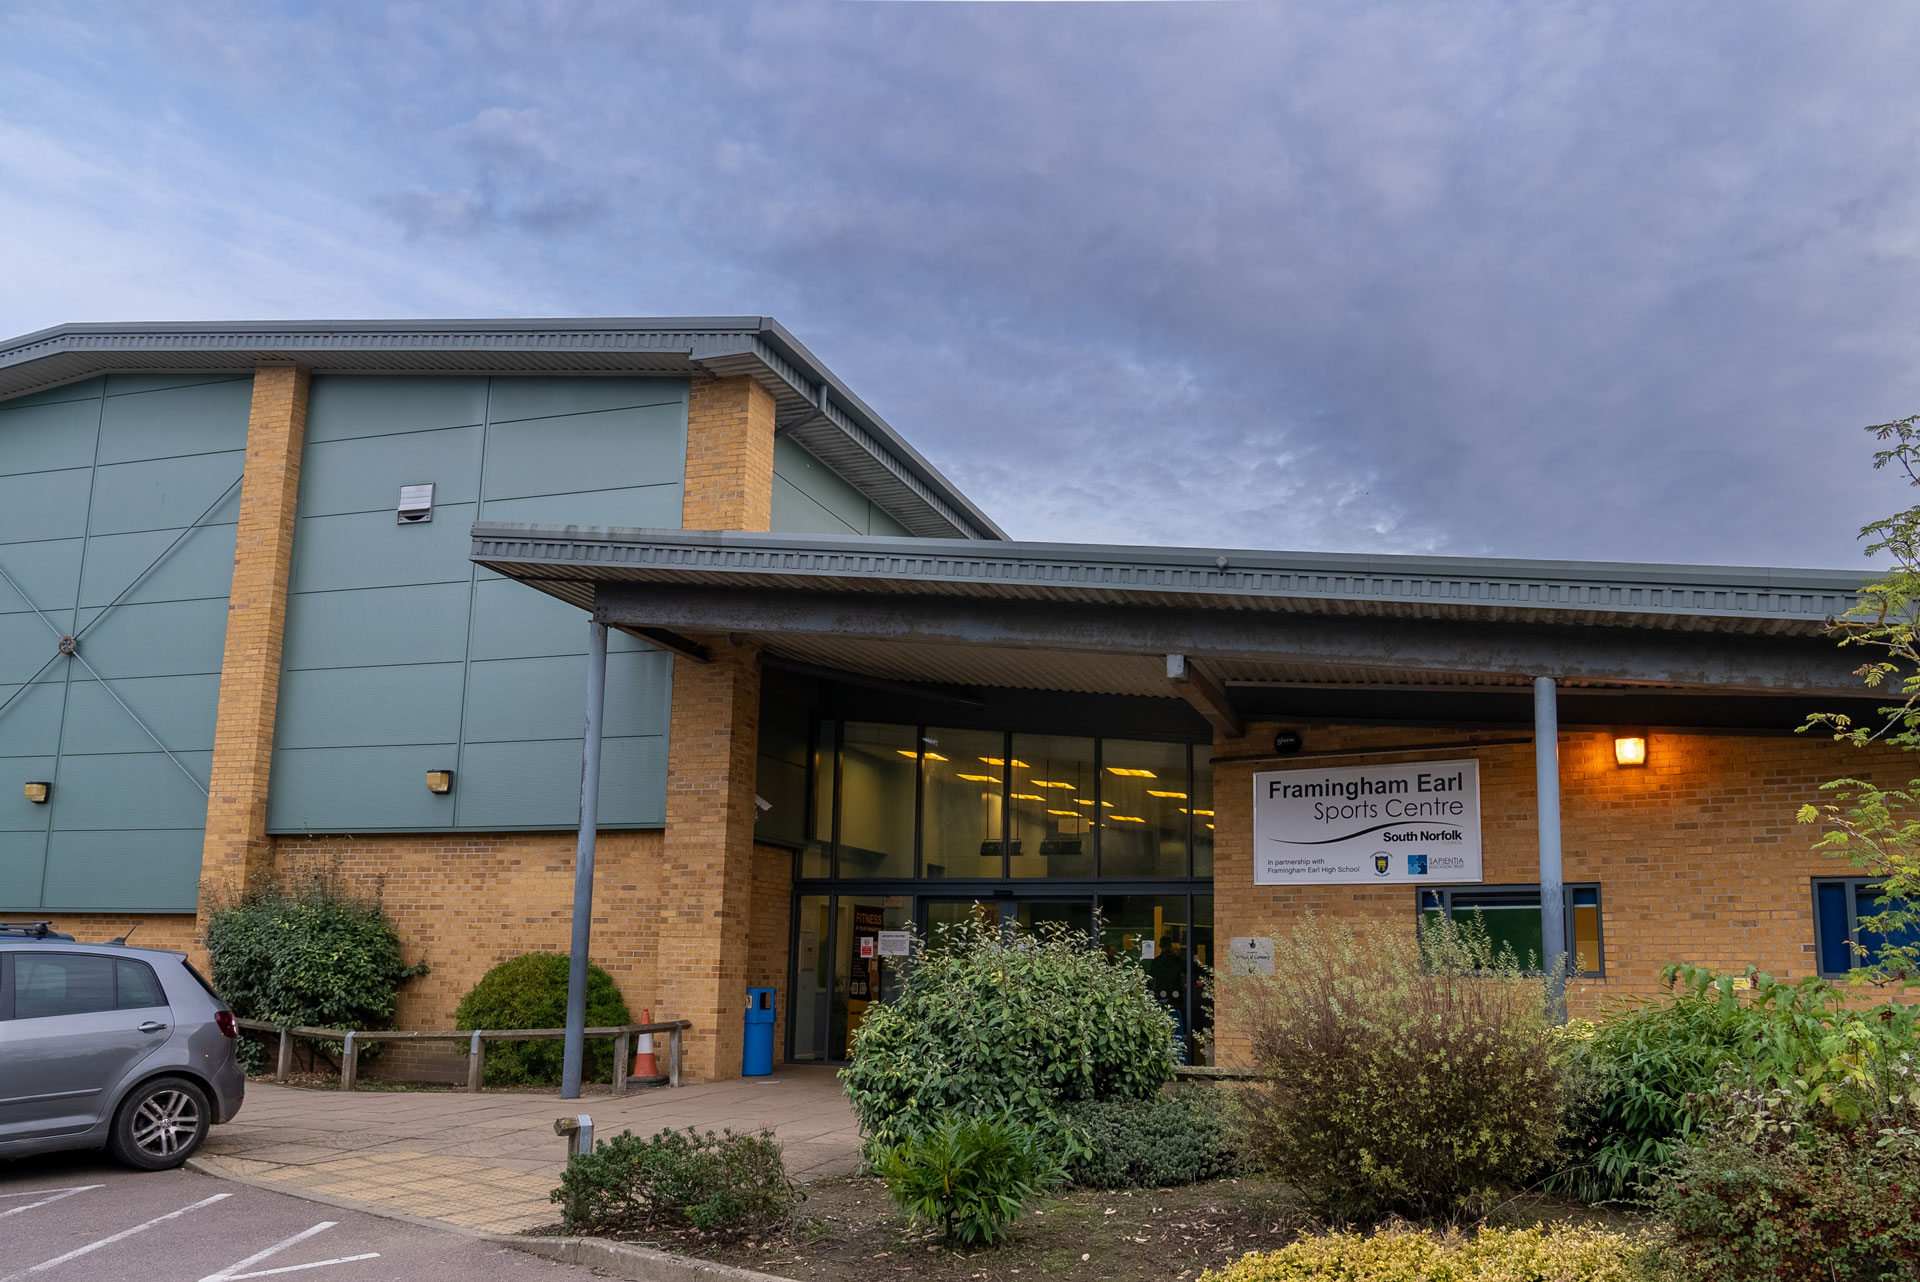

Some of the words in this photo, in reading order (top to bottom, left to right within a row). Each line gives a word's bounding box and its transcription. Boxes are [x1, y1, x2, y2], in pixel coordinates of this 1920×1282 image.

[1269, 777, 1409, 800] Framingham
[1417, 772, 1463, 793] Earl
[1314, 800, 1378, 824] Sports
[1385, 797, 1464, 818] Centre
[1383, 831, 1418, 842] South
[1420, 830, 1463, 841] Norfolk
[1275, 858, 1311, 867] partnership
[1429, 857, 1464, 865] SAPIENTIA
[1267, 866, 1306, 875] Framingham
[1322, 866, 1336, 874] High
[1337, 865, 1360, 873] School
[856, 913, 882, 925] FITNESS
